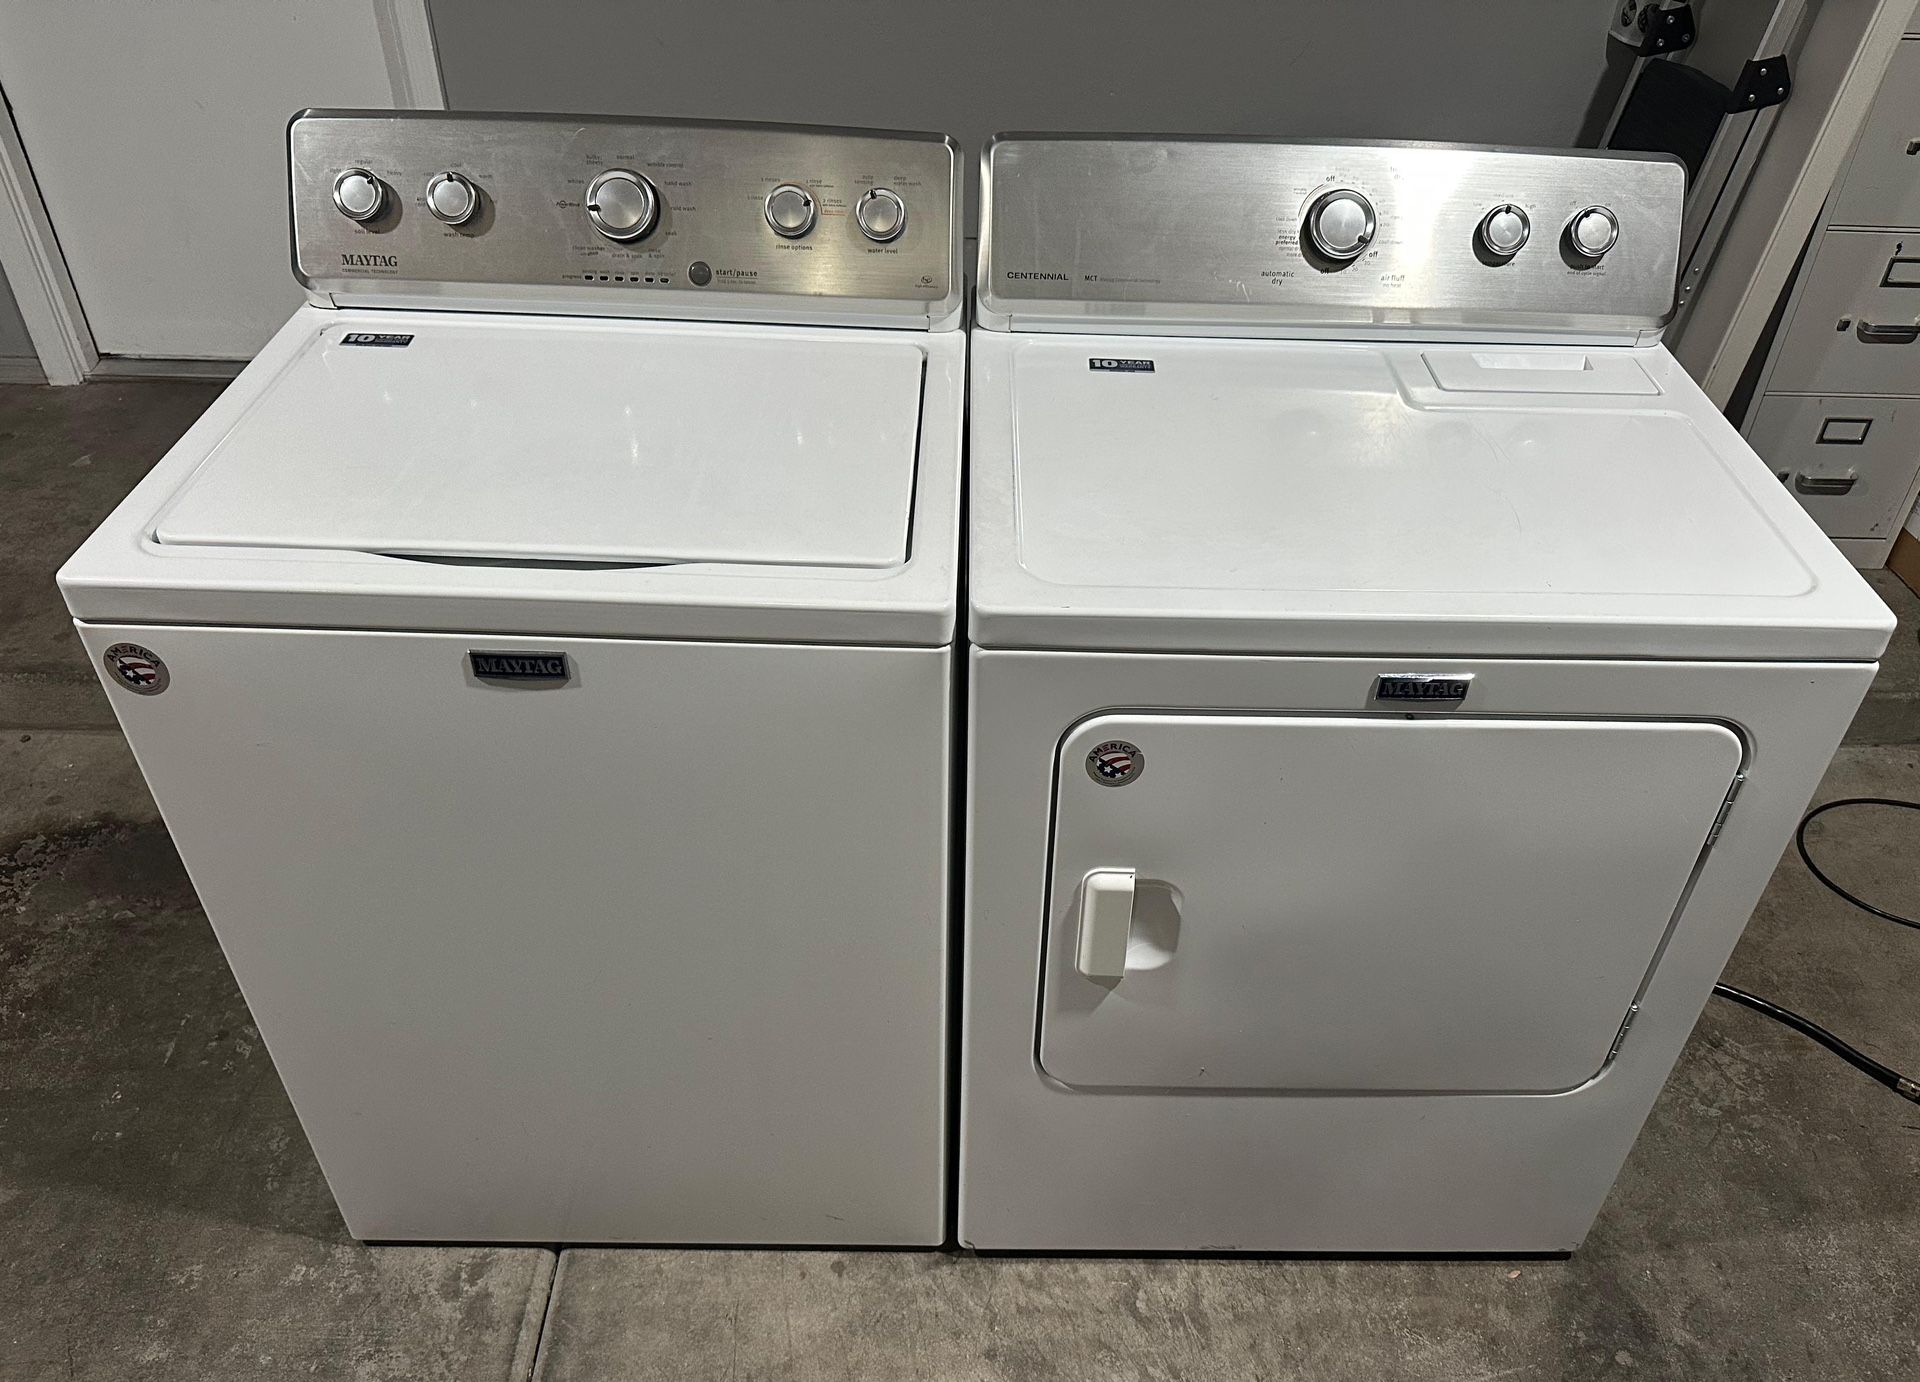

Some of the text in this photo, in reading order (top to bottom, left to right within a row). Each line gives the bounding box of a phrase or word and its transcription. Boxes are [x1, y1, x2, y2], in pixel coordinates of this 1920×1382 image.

[341, 254, 398, 267] MAYTAG
[715, 268, 758, 278] start/pause
[1007, 271, 1069, 281] CENTENNIAL
[1271, 277, 1283, 285] dry
[348, 334, 376, 342] 10
[1092, 360, 1118, 368] 10
[107, 645, 160, 667] AMERICA
[476, 657, 562, 674] MAYTAG
[1381, 682, 1464, 696] MAYTAG
[1088, 743, 1137, 762] AMERICA
